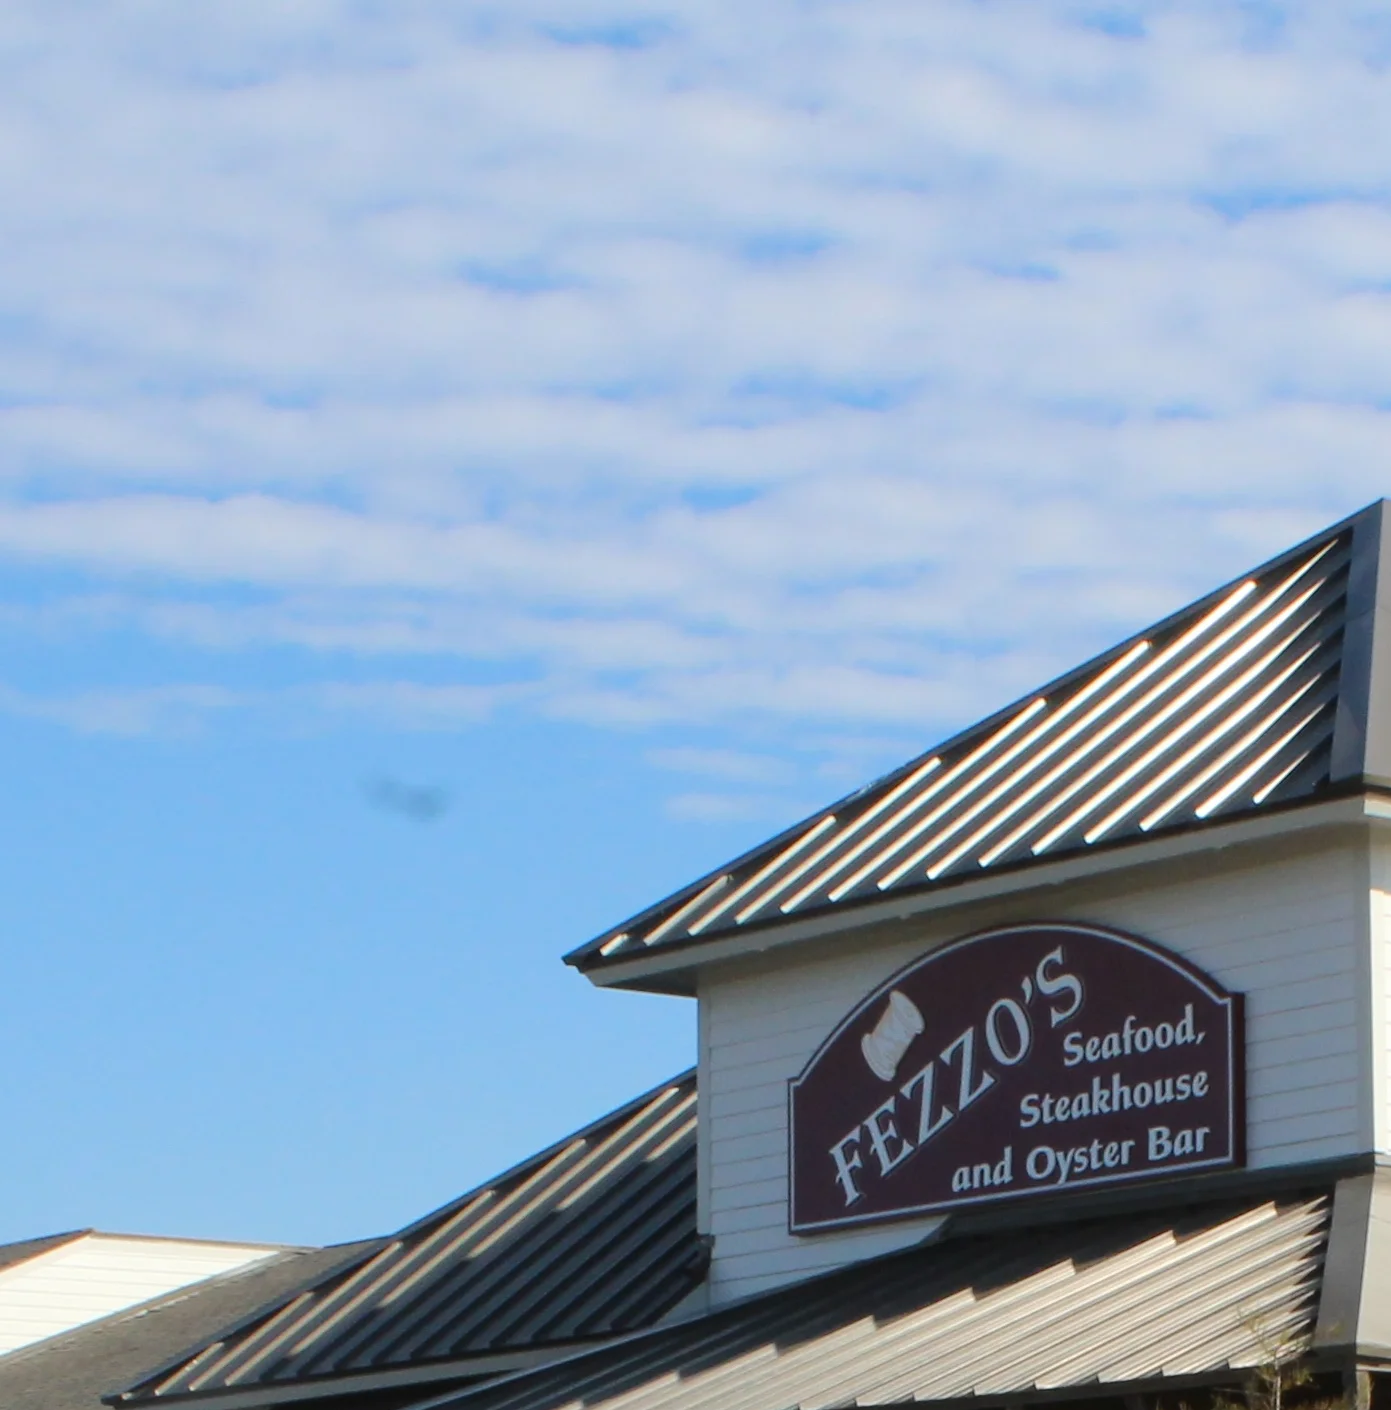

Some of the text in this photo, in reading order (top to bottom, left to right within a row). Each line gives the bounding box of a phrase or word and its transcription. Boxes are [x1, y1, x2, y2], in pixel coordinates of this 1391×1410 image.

[1063, 1003, 1206, 1067] Seafood,
[828, 945, 1084, 1206] FEZZO'S
[1019, 1070, 1209, 1128] Steakhouse
[951, 1124, 1210, 1193] and Oyster Bar
